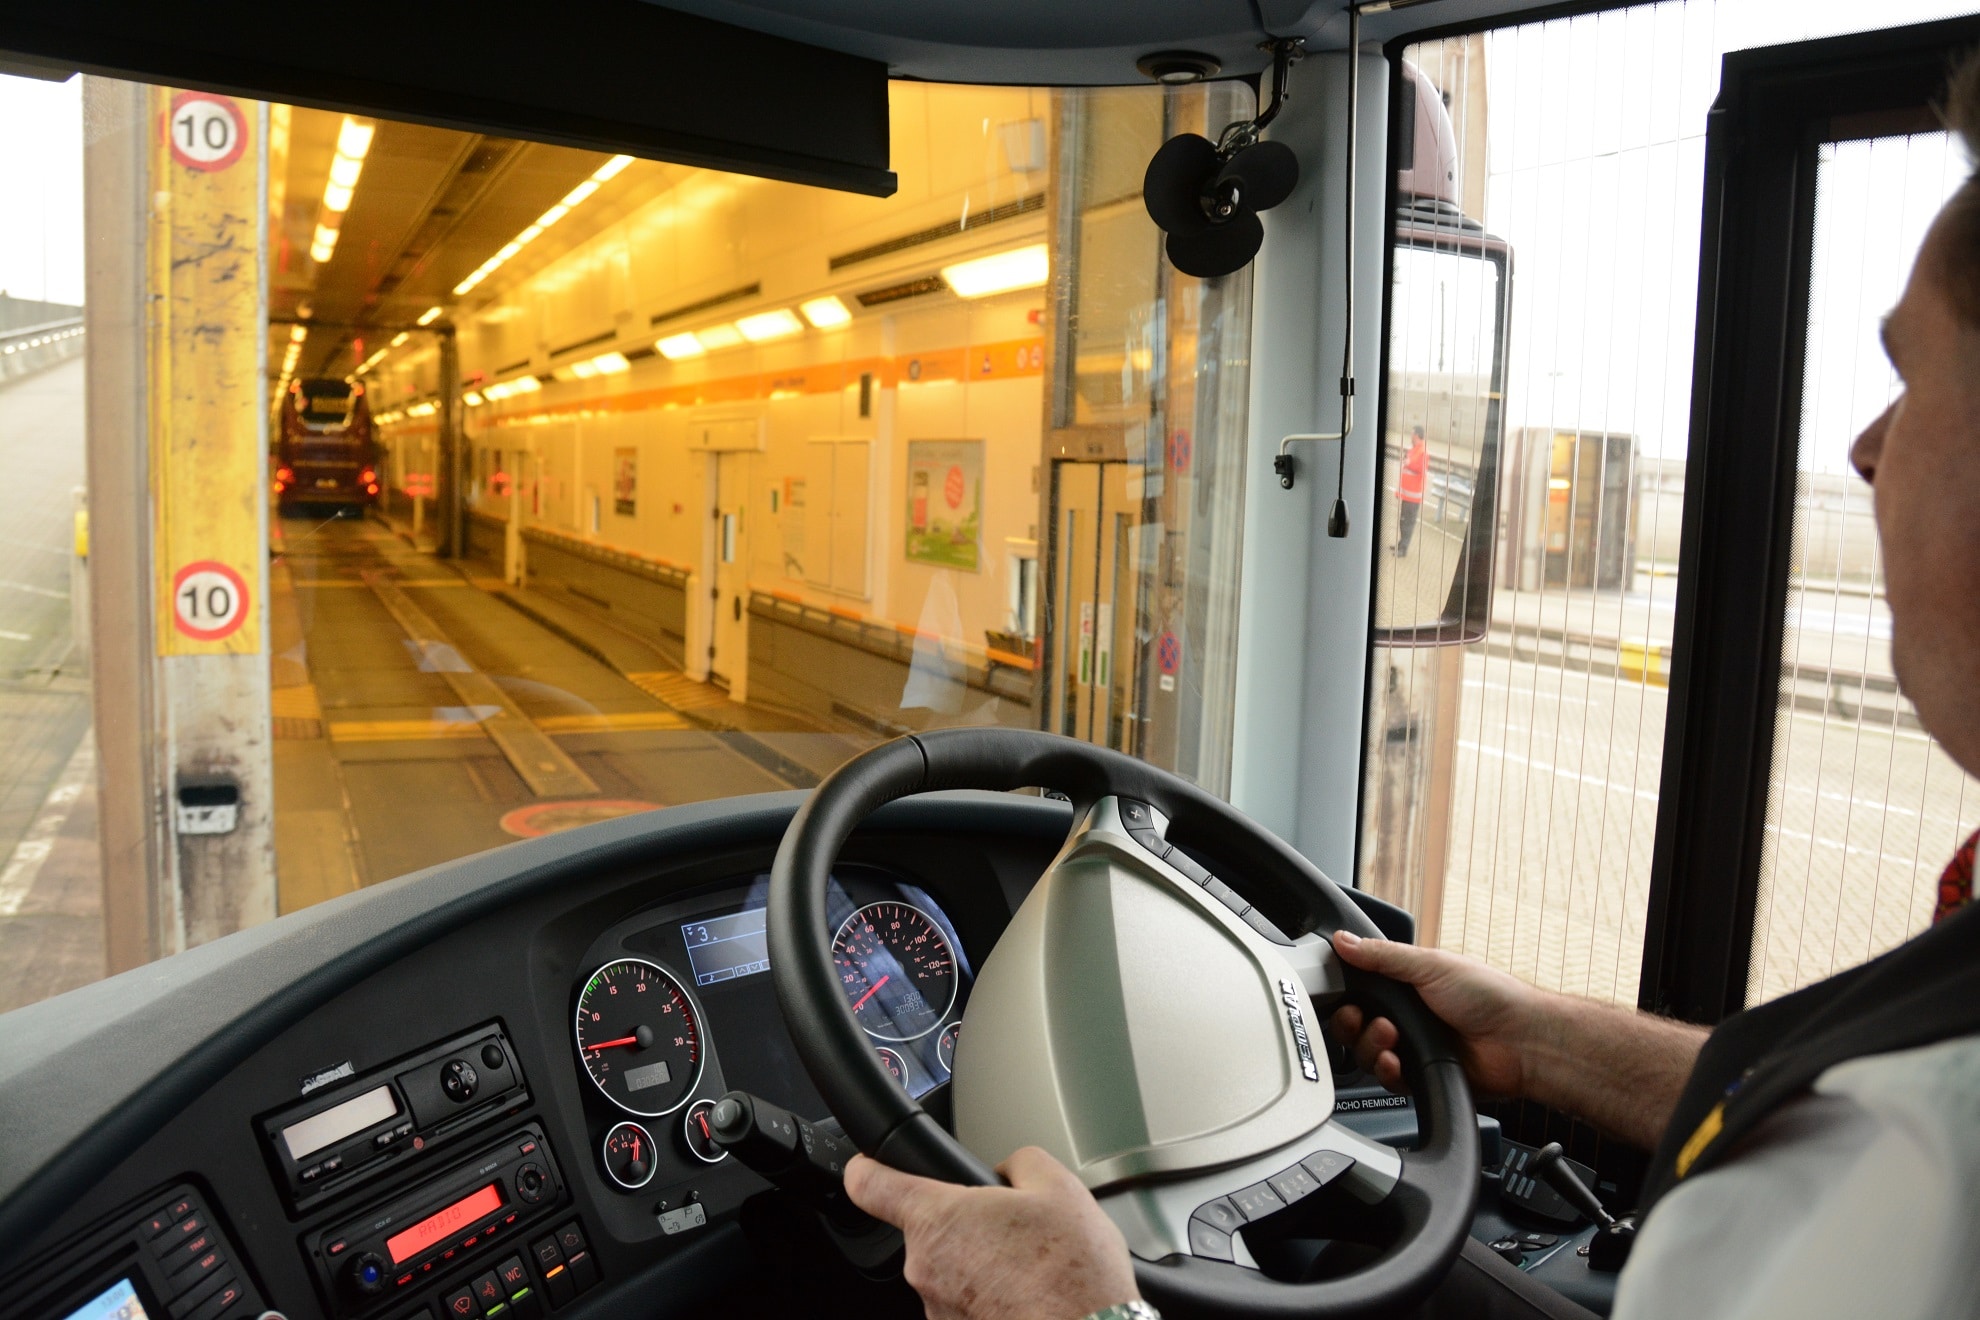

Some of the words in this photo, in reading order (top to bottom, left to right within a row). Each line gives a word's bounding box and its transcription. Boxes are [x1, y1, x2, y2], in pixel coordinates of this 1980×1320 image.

[178, 114, 228, 150] 10
[181, 585, 231, 618] 10
[864, 924, 875, 933] 60
[890, 921, 901, 930] 80
[698, 926, 708, 942] 3
[914, 935, 927, 945] 100
[845, 945, 856, 954] 40
[928, 960, 940, 970] 120
[844, 974, 854, 984] 20
[609, 985, 618, 995] 15
[636, 983, 646, 993] 20
[662, 1004, 672, 1013] 25
[591, 1012, 600, 1022] 10
[1279, 978, 1319, 1082] NEOPLAN
[674, 1037, 684, 1047] 30
[595, 1050, 601, 1059] 5
[1334, 1100, 1360, 1110] ACHO
[1361, 1097, 1406, 1108] REMINDER
[418, 1206, 462, 1238] RADIO
[190, 1237, 206, 1252] TRAF
[464, 1236, 478, 1247] VIDEO
[201, 1254, 216, 1268] MAP
[397, 1274, 412, 1285] RADIO
[505, 1267, 522, 1282] WC
